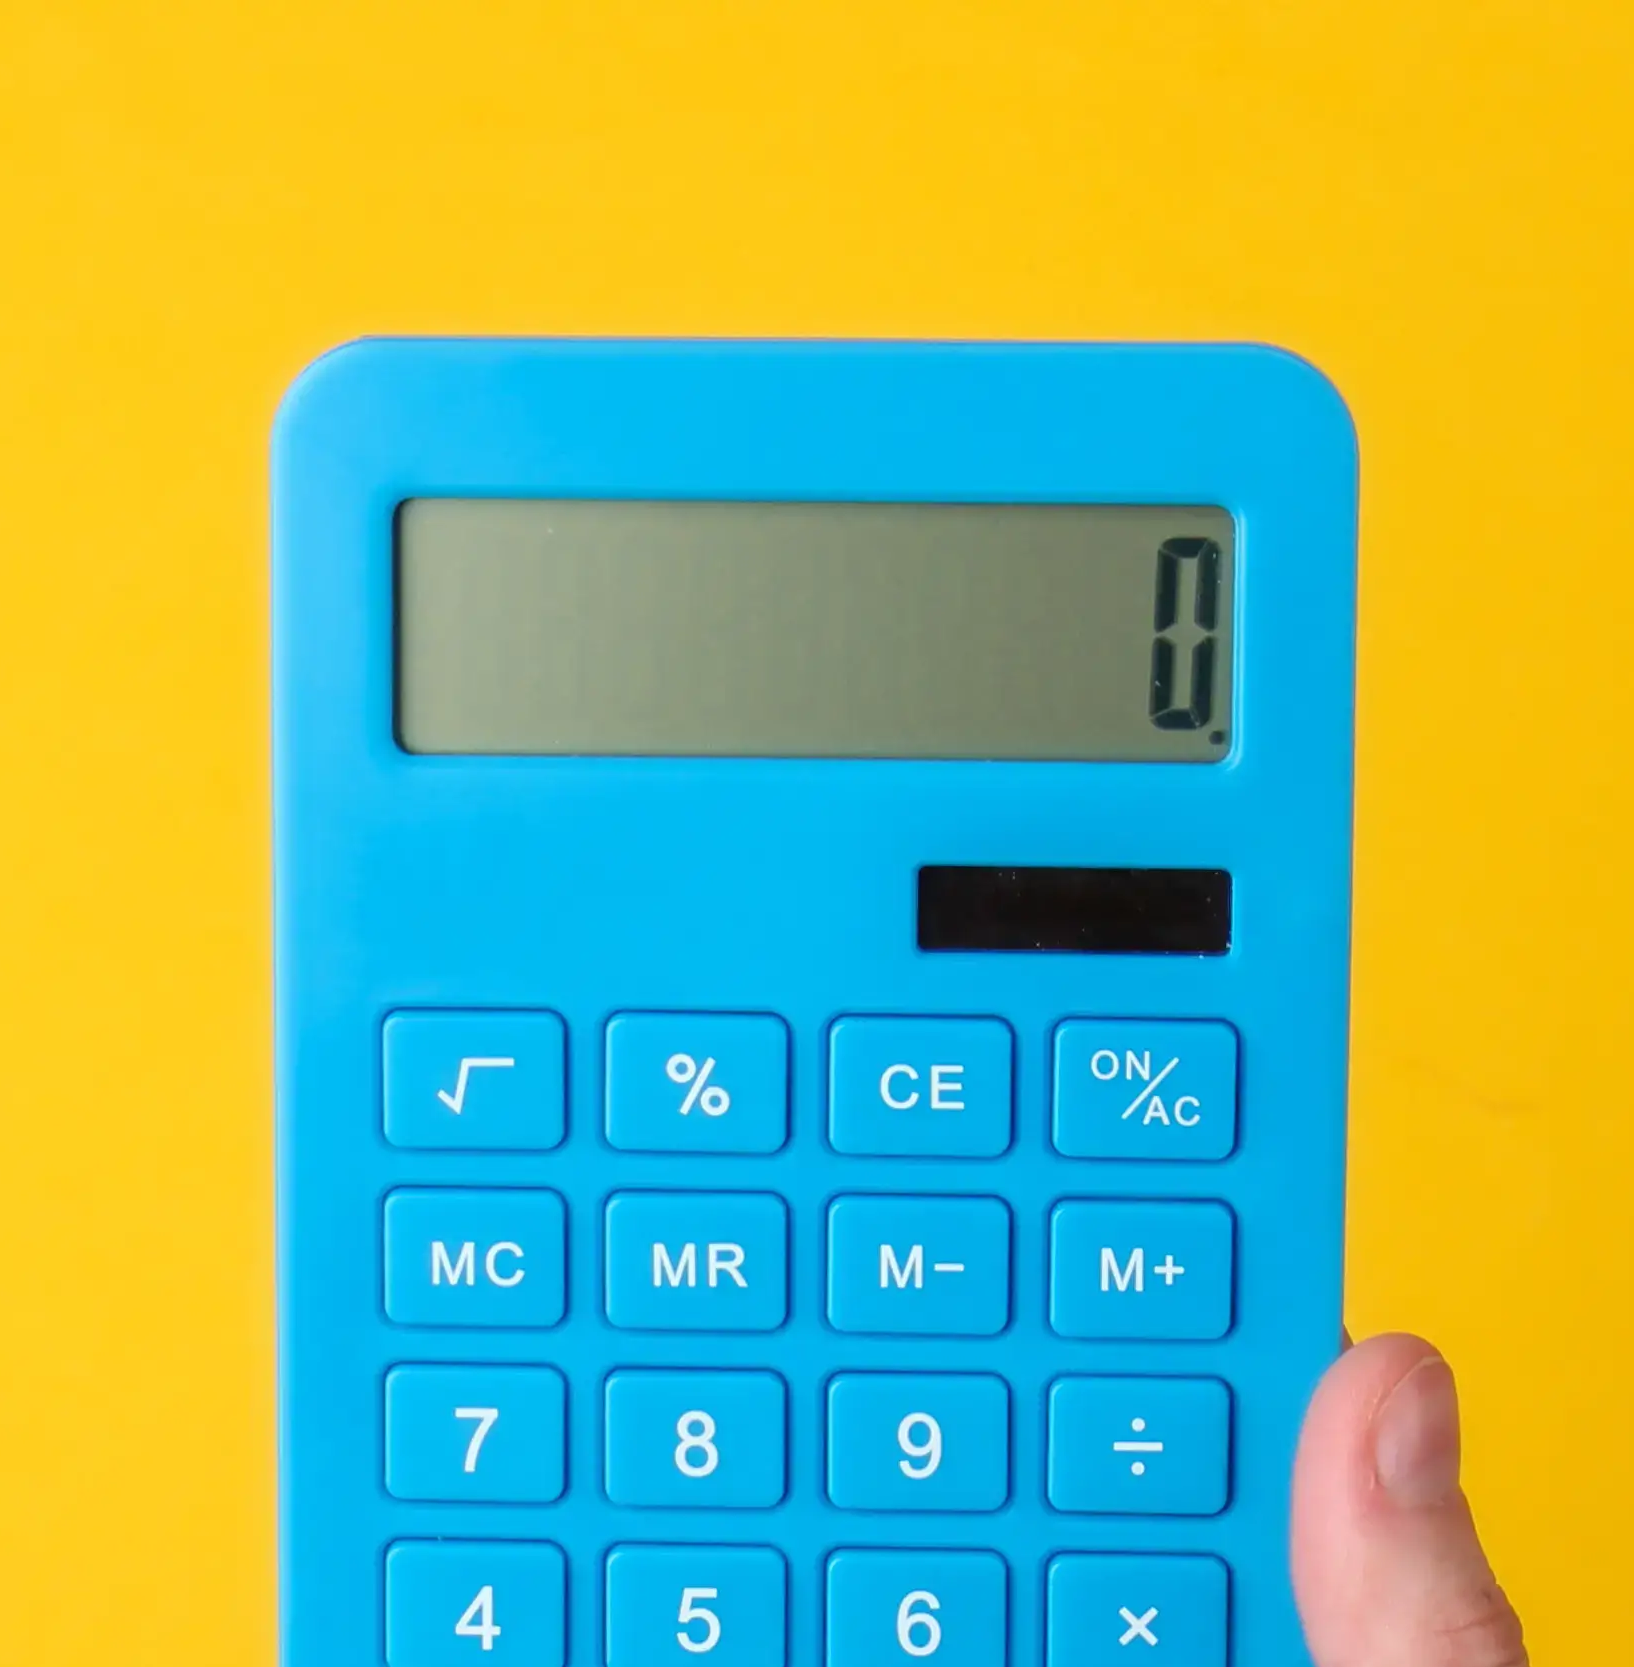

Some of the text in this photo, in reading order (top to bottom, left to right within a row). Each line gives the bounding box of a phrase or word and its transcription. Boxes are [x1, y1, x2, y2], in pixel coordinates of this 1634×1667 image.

[880, 1064, 965, 1110] CE
[431, 1240, 525, 1287] MC
[652, 1242, 748, 1288] MR
[1100, 1247, 1185, 1293] M+
[454, 1407, 499, 1474] 7
[674, 1410, 719, 1478] 8
[897, 1412, 943, 1479] 9
[454, 1585, 502, 1651] 4
[676, 1587, 722, 1653] 5
[896, 1590, 942, 1657] 6
